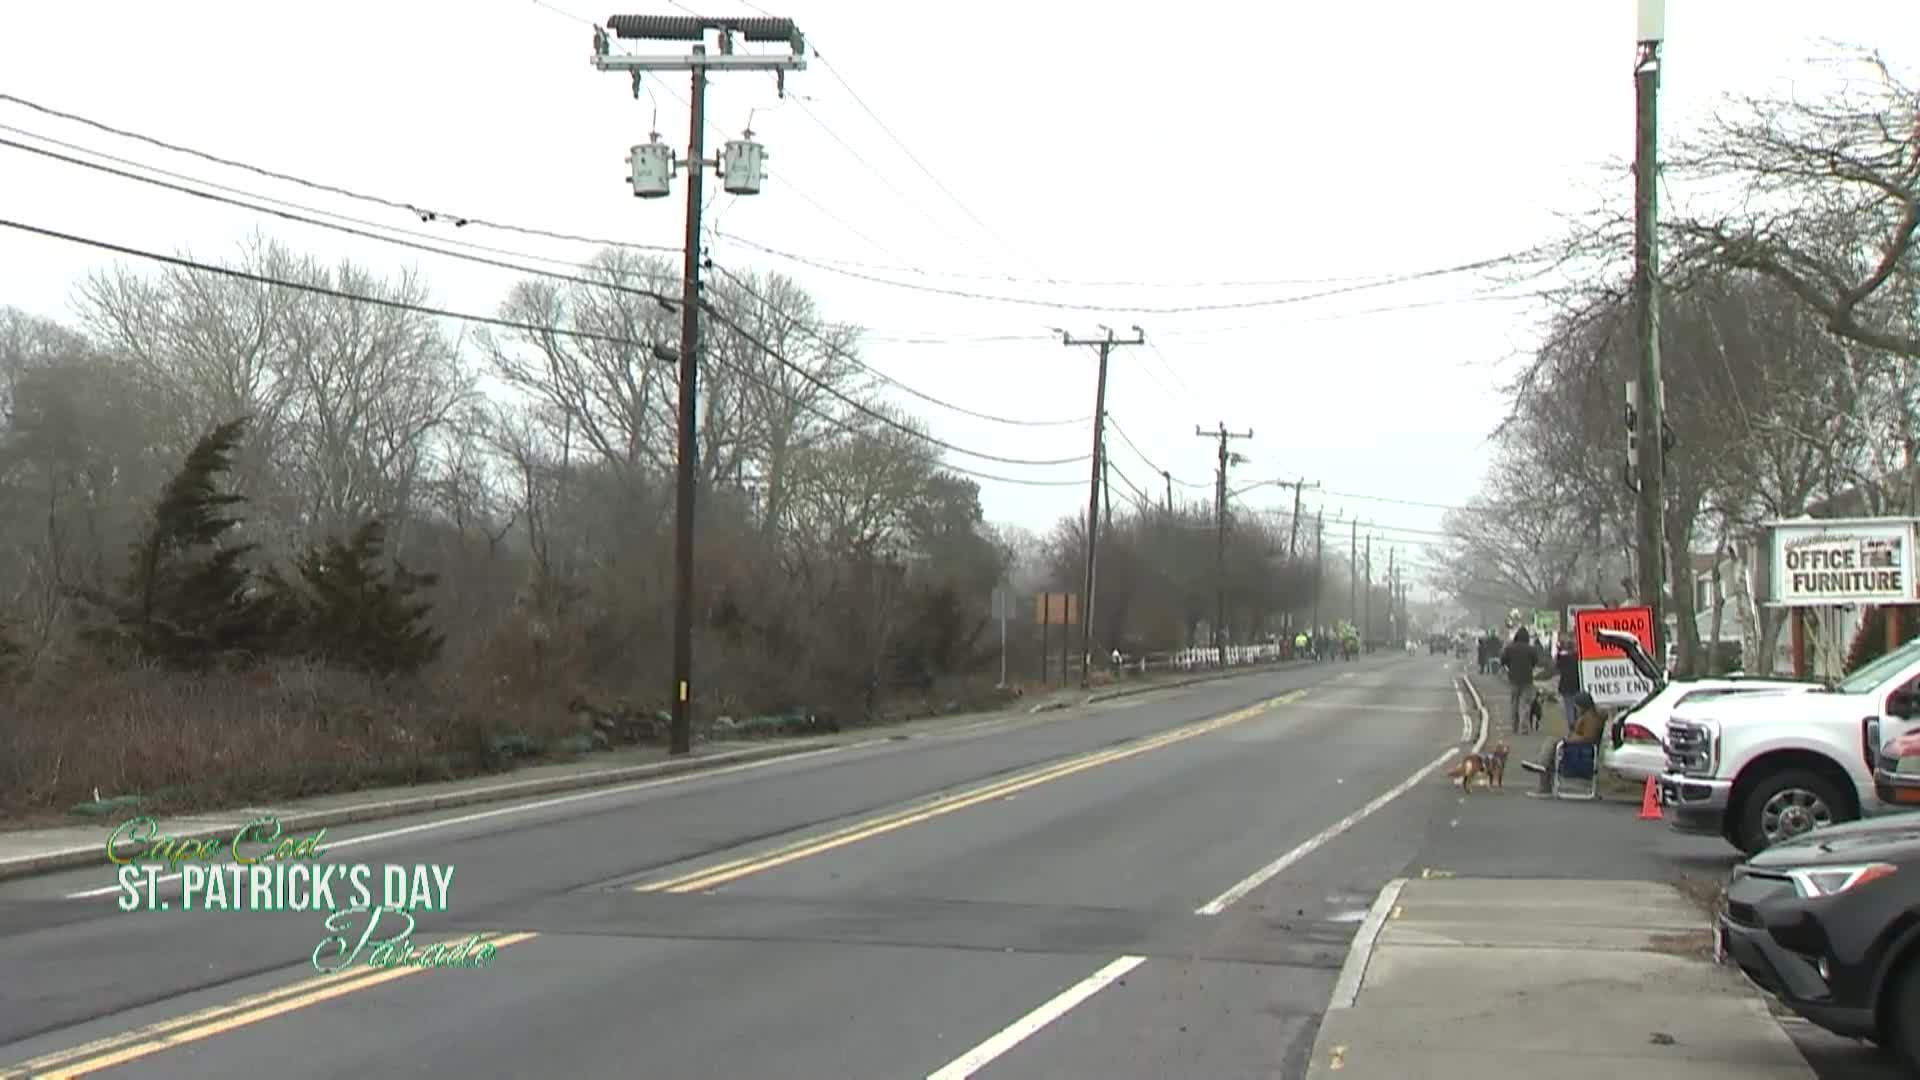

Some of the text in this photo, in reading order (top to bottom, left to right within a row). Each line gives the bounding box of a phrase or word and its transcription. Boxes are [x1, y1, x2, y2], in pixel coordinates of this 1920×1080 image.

[1785, 549, 1855, 570] OFFICE
[1792, 571, 1903, 593] FURNITURE
[1613, 617, 1645, 633] ROAD
[1593, 665, 1634, 679] DOUBL
[1588, 681, 1621, 696] FINES
